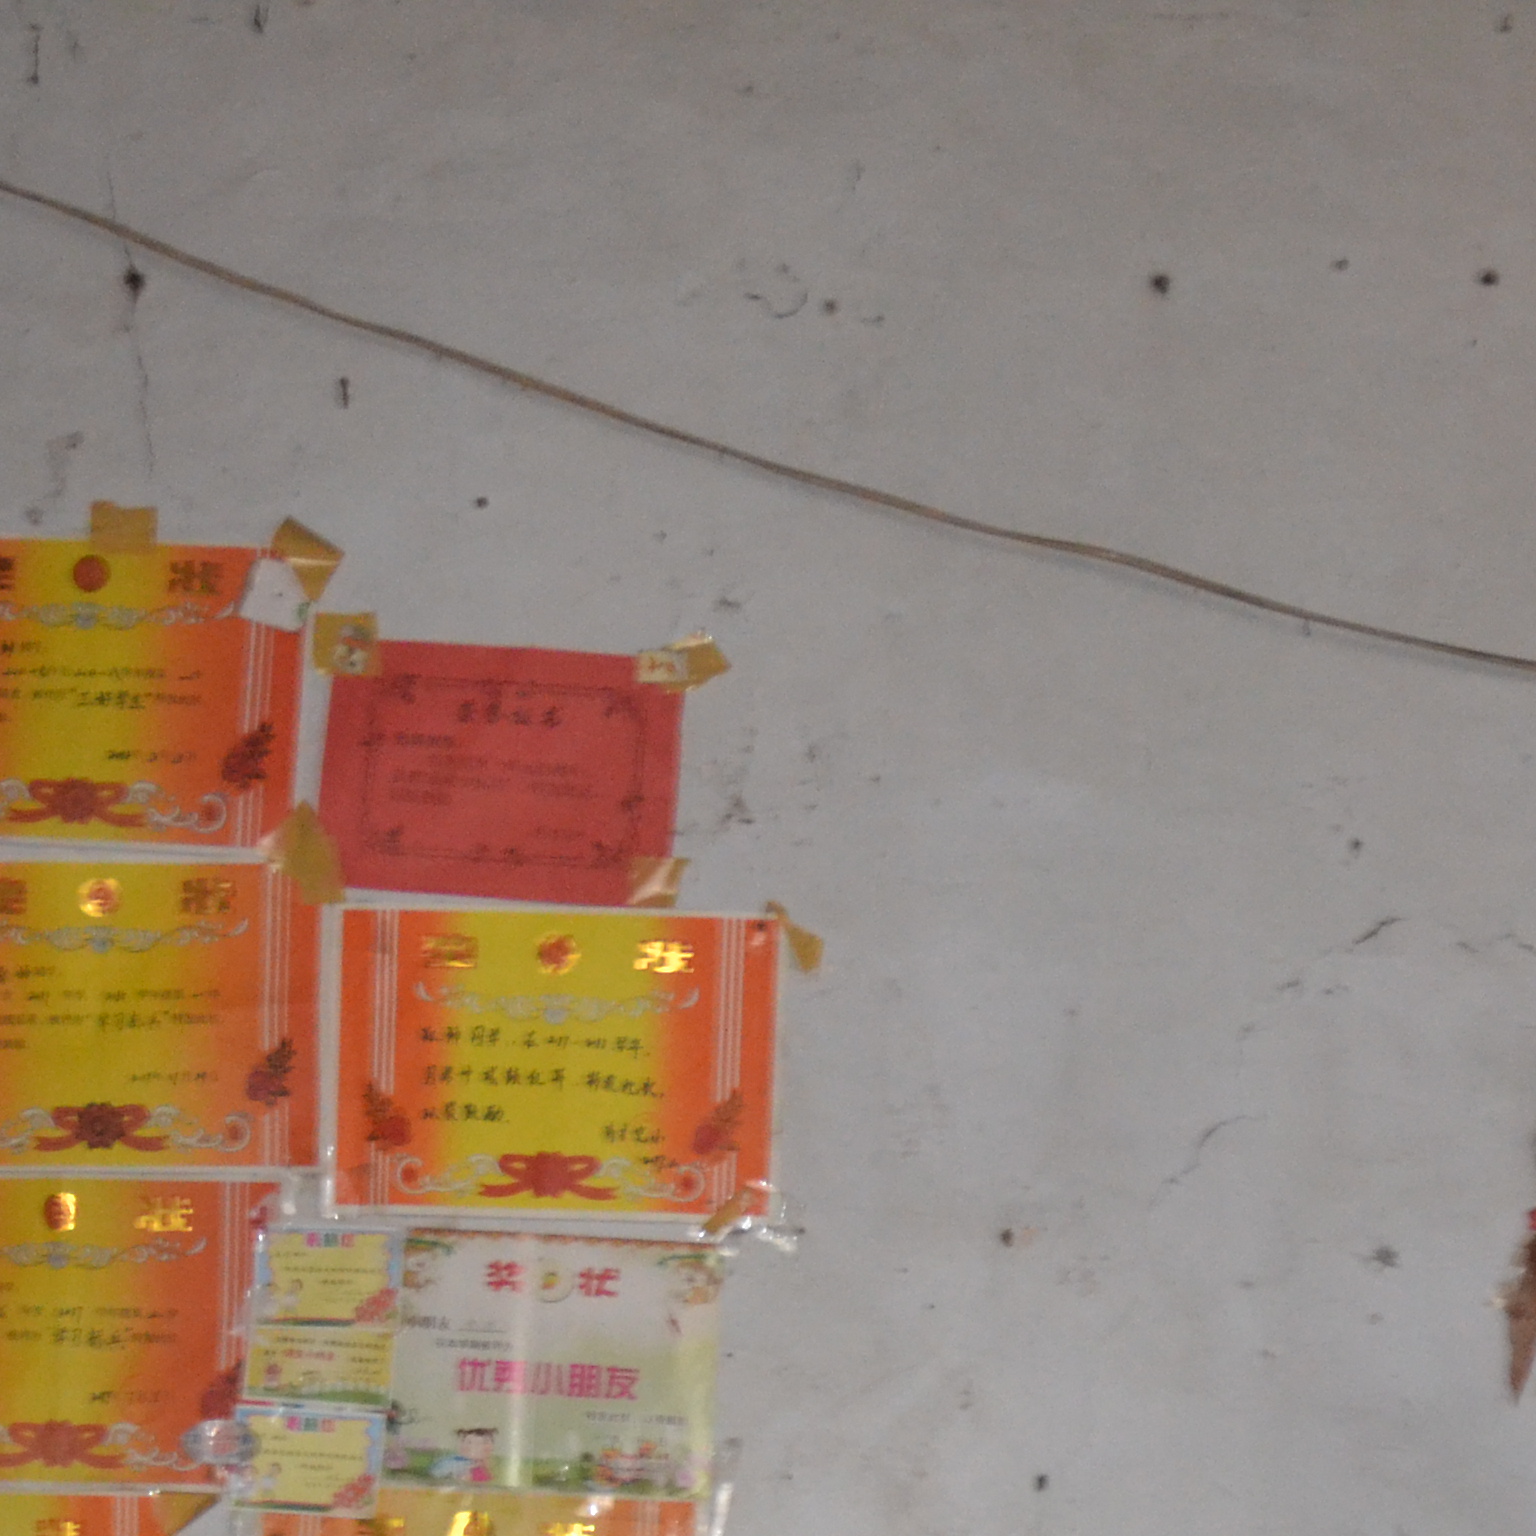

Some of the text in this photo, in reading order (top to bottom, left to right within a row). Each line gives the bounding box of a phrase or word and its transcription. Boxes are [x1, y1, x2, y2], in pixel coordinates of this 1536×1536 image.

[457, 1358, 640, 1400] 优秀小朋友
